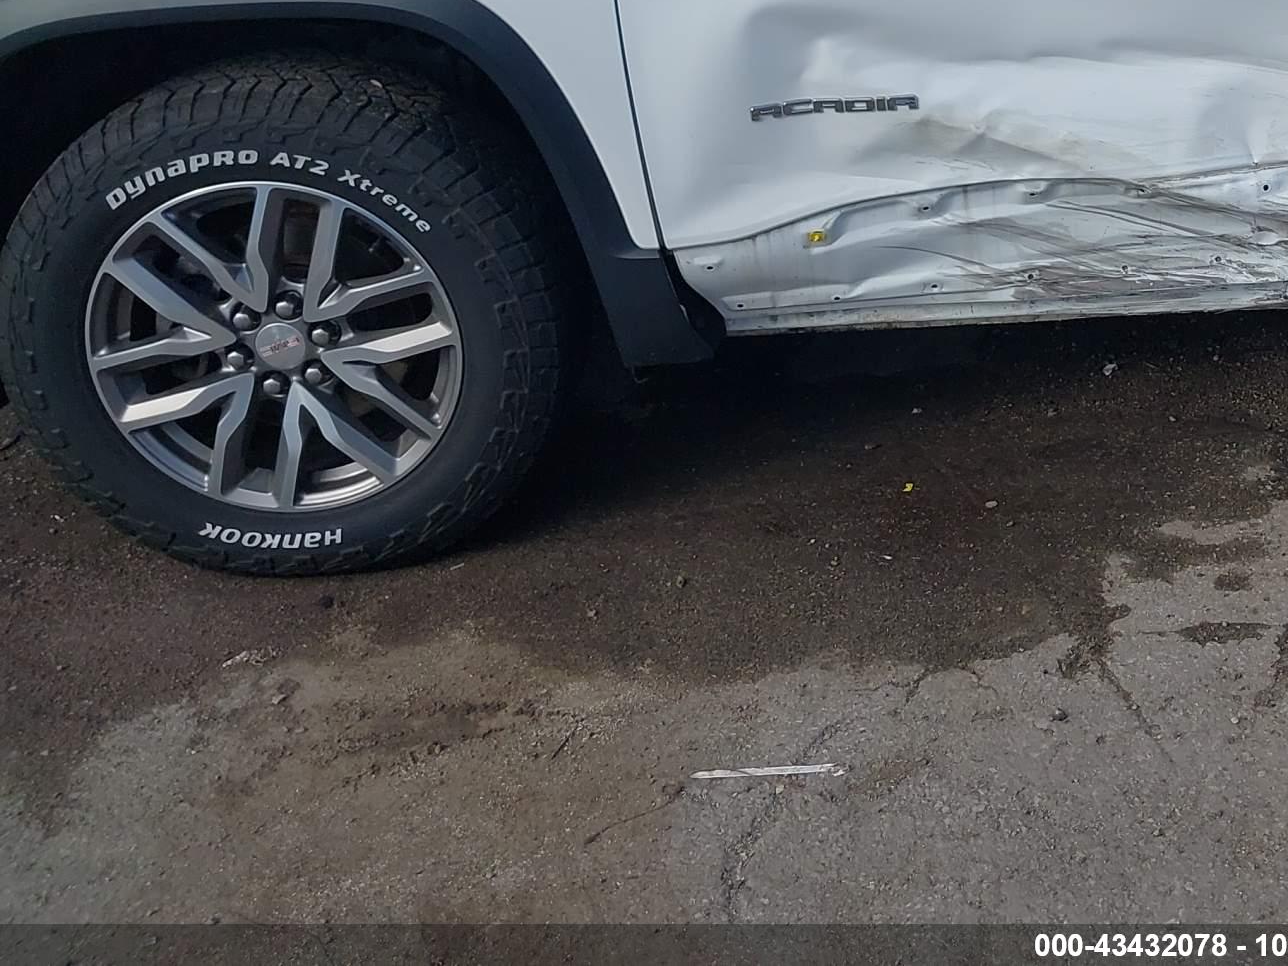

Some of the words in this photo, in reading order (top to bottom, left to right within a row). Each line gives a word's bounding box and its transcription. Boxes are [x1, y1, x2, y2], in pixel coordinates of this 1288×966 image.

[750, 94, 919, 121] ACADIA
[269, 151, 330, 175] AT2
[337, 169, 431, 233] Xtreme
